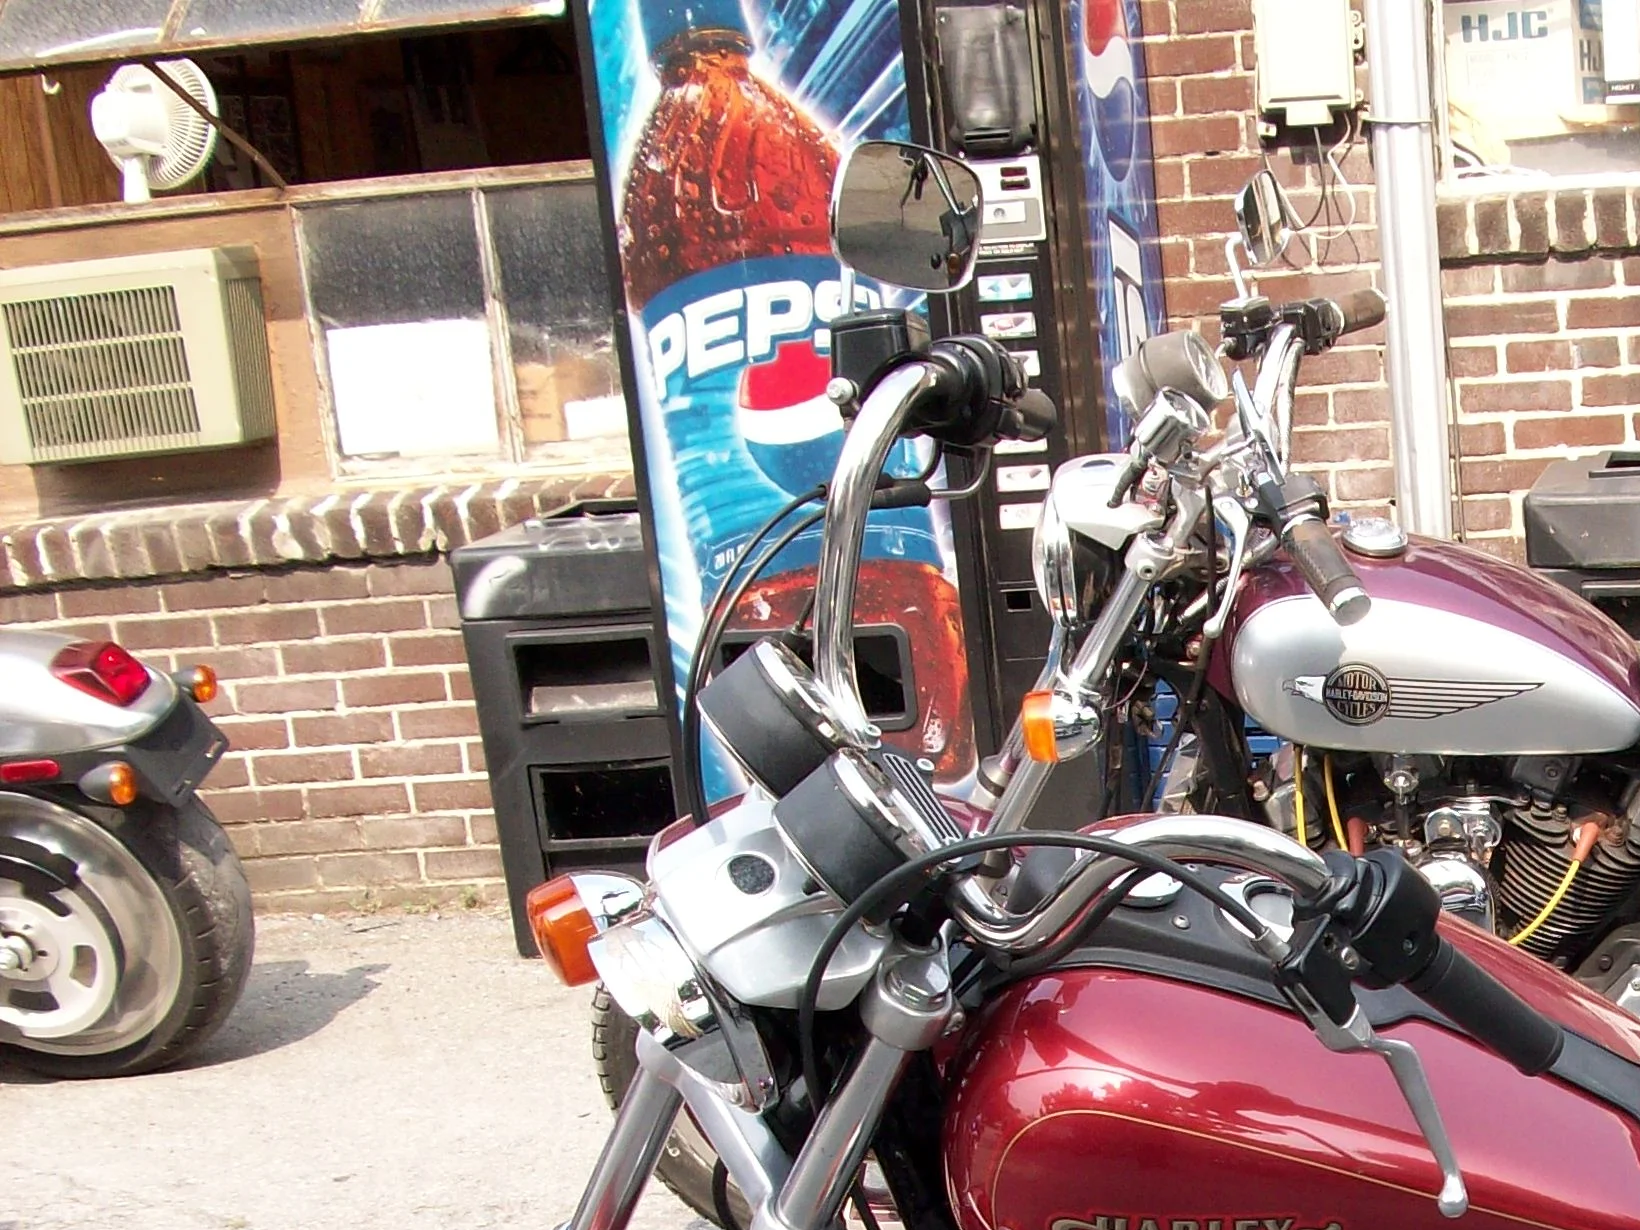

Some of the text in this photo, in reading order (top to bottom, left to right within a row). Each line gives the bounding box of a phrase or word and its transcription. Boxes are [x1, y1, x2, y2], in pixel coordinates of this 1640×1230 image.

[1461, 11, 1548, 43] HJC
[1579, 39, 1602, 72] HJ
[648, 279, 881, 400] PEPS
[1337, 671, 1377, 690] MOTOR
[1336, 701, 1376, 718] CYCLES
